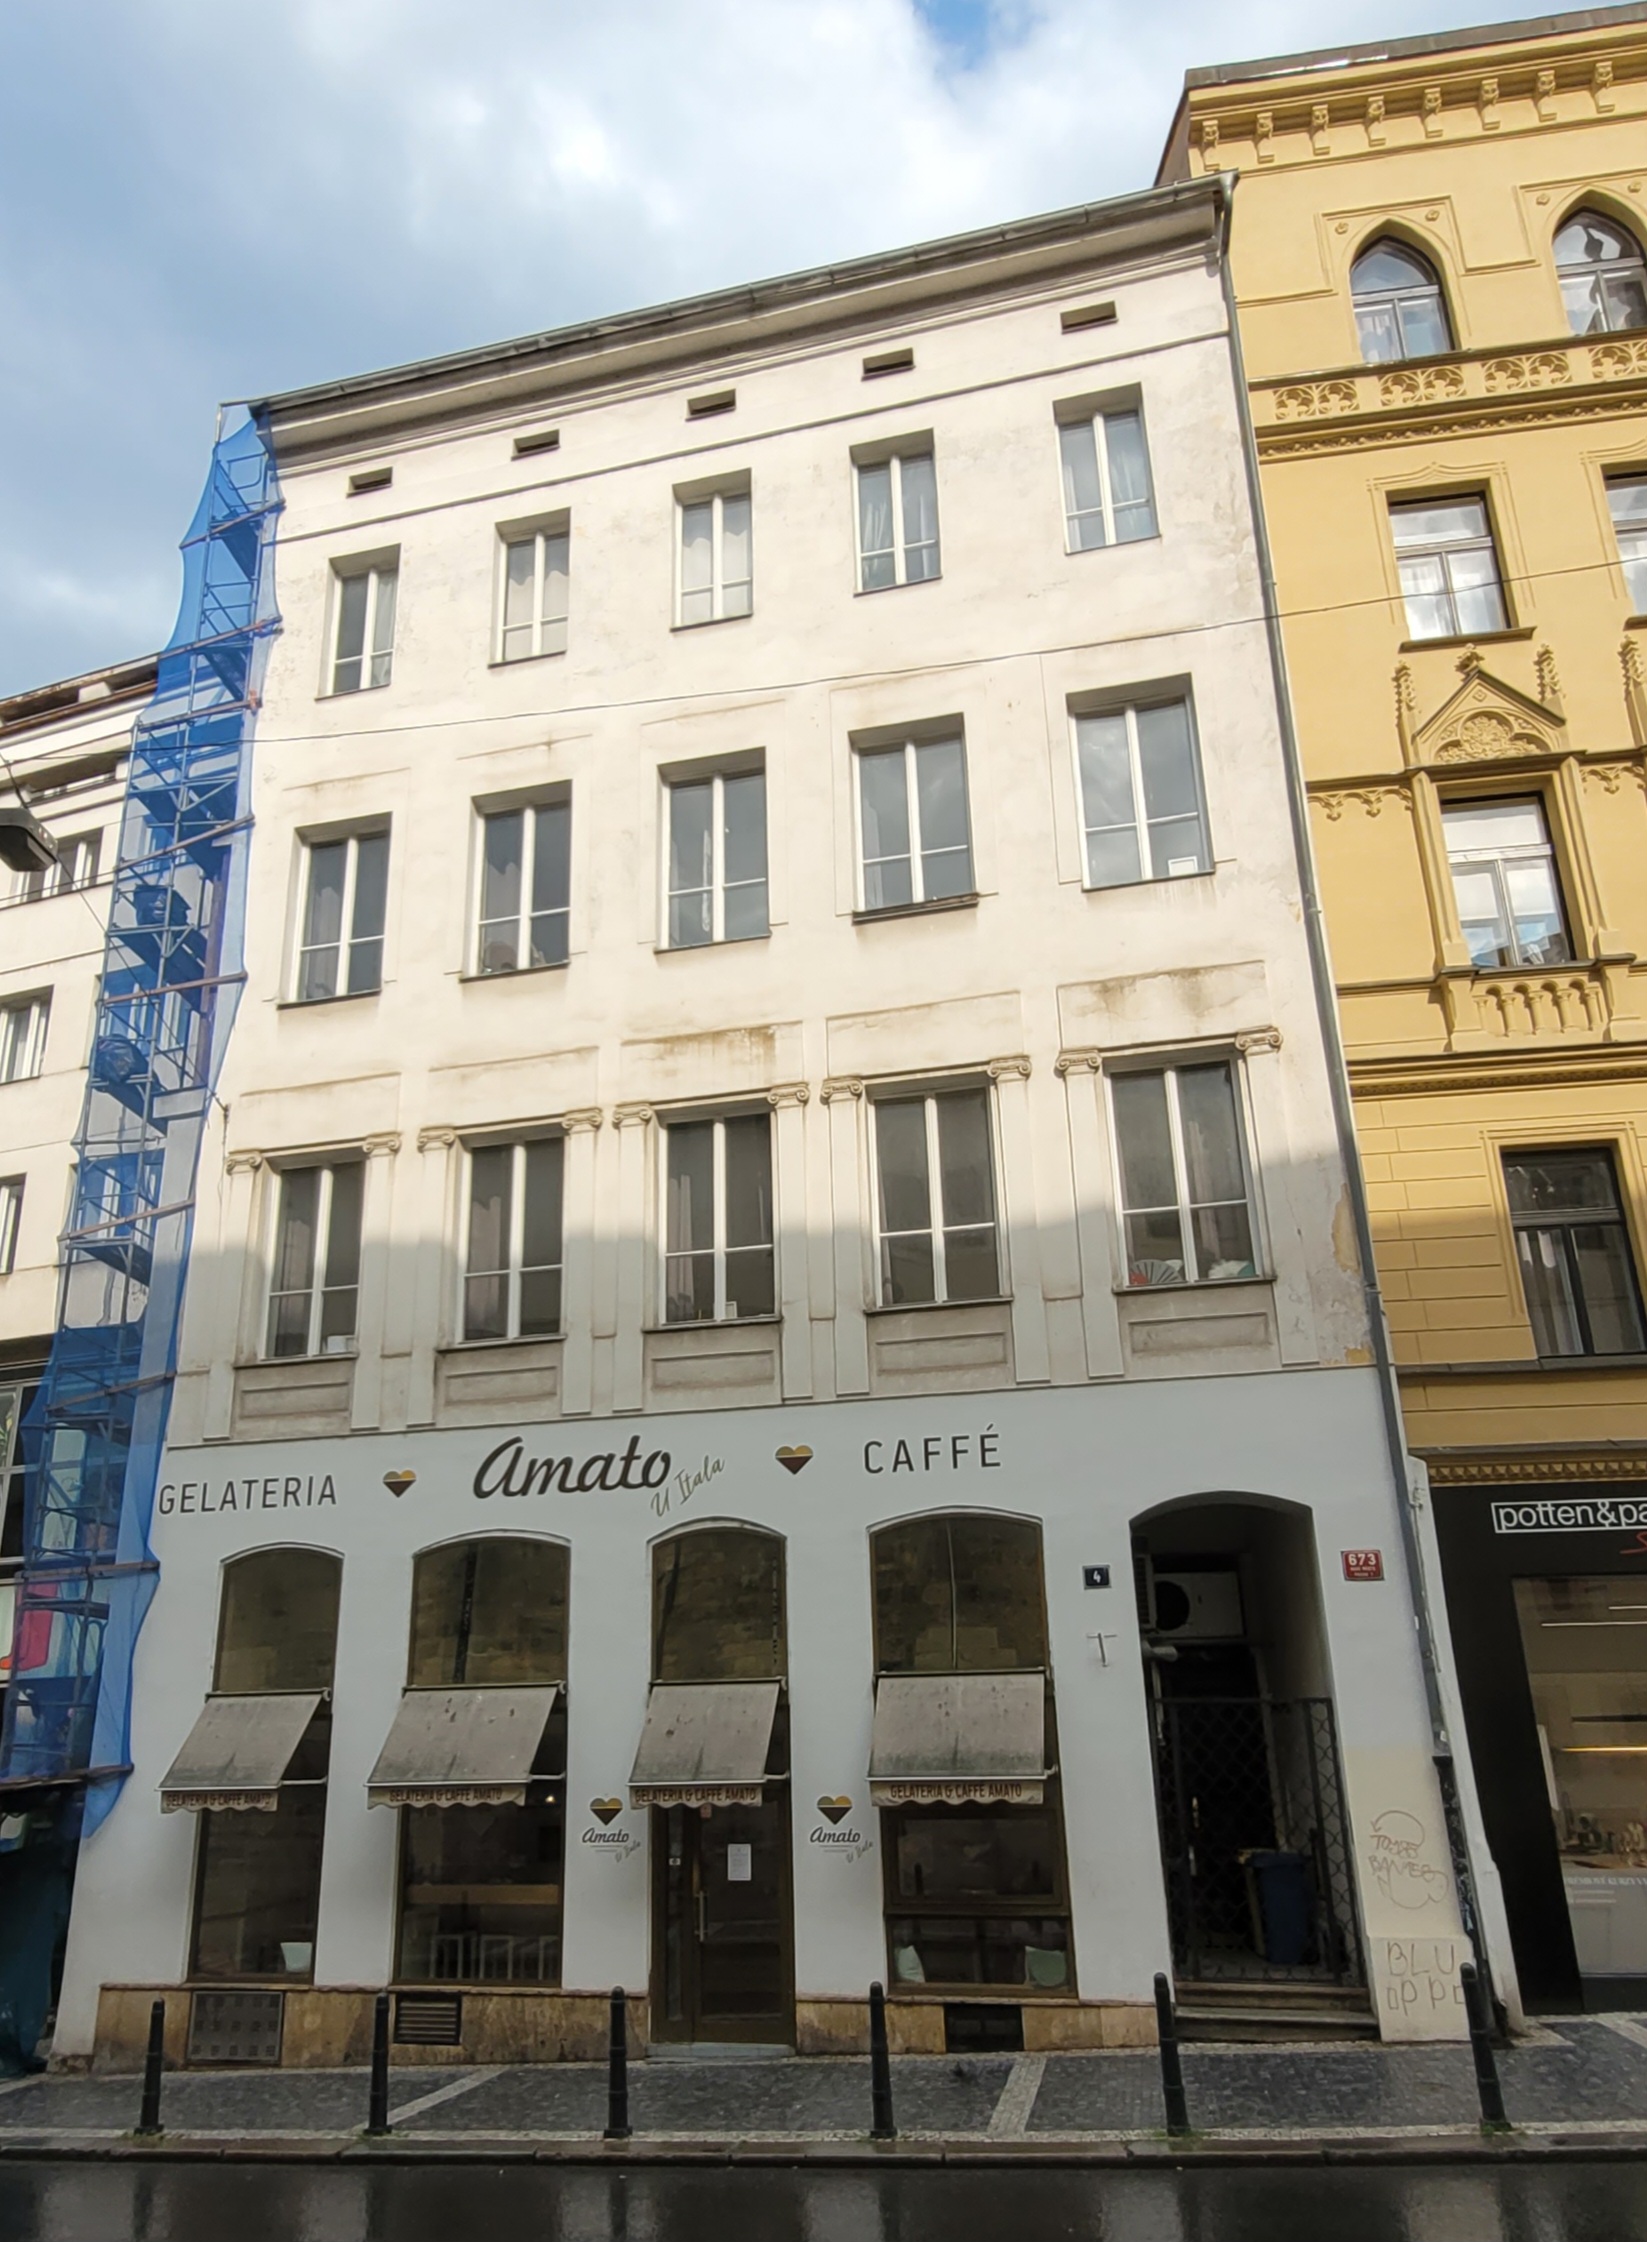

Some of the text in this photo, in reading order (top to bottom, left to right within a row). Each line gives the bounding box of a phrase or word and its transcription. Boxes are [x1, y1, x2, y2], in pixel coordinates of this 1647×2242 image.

[863, 1423, 1002, 1474] CAFFÉ
[473, 1435, 671, 1499] Amato
[674, 1455, 726, 1506] Itala
[157, 1474, 338, 1516] GELATERIA
[1348, 1553, 1377, 1566] 673
[1093, 1570, 1101, 1583] 4
[473, 1787, 503, 1800] AMATO
[634, 1788, 684, 1802] GELATERIA
[725, 1787, 757, 1801] AMATO
[890, 1784, 943, 1799] GELATERIA
[988, 1783, 1023, 1798] AMATO
[581, 1827, 630, 1844] Amato
[810, 1826, 861, 1843] Amato
[1386, 1941, 1455, 1977] BLU
